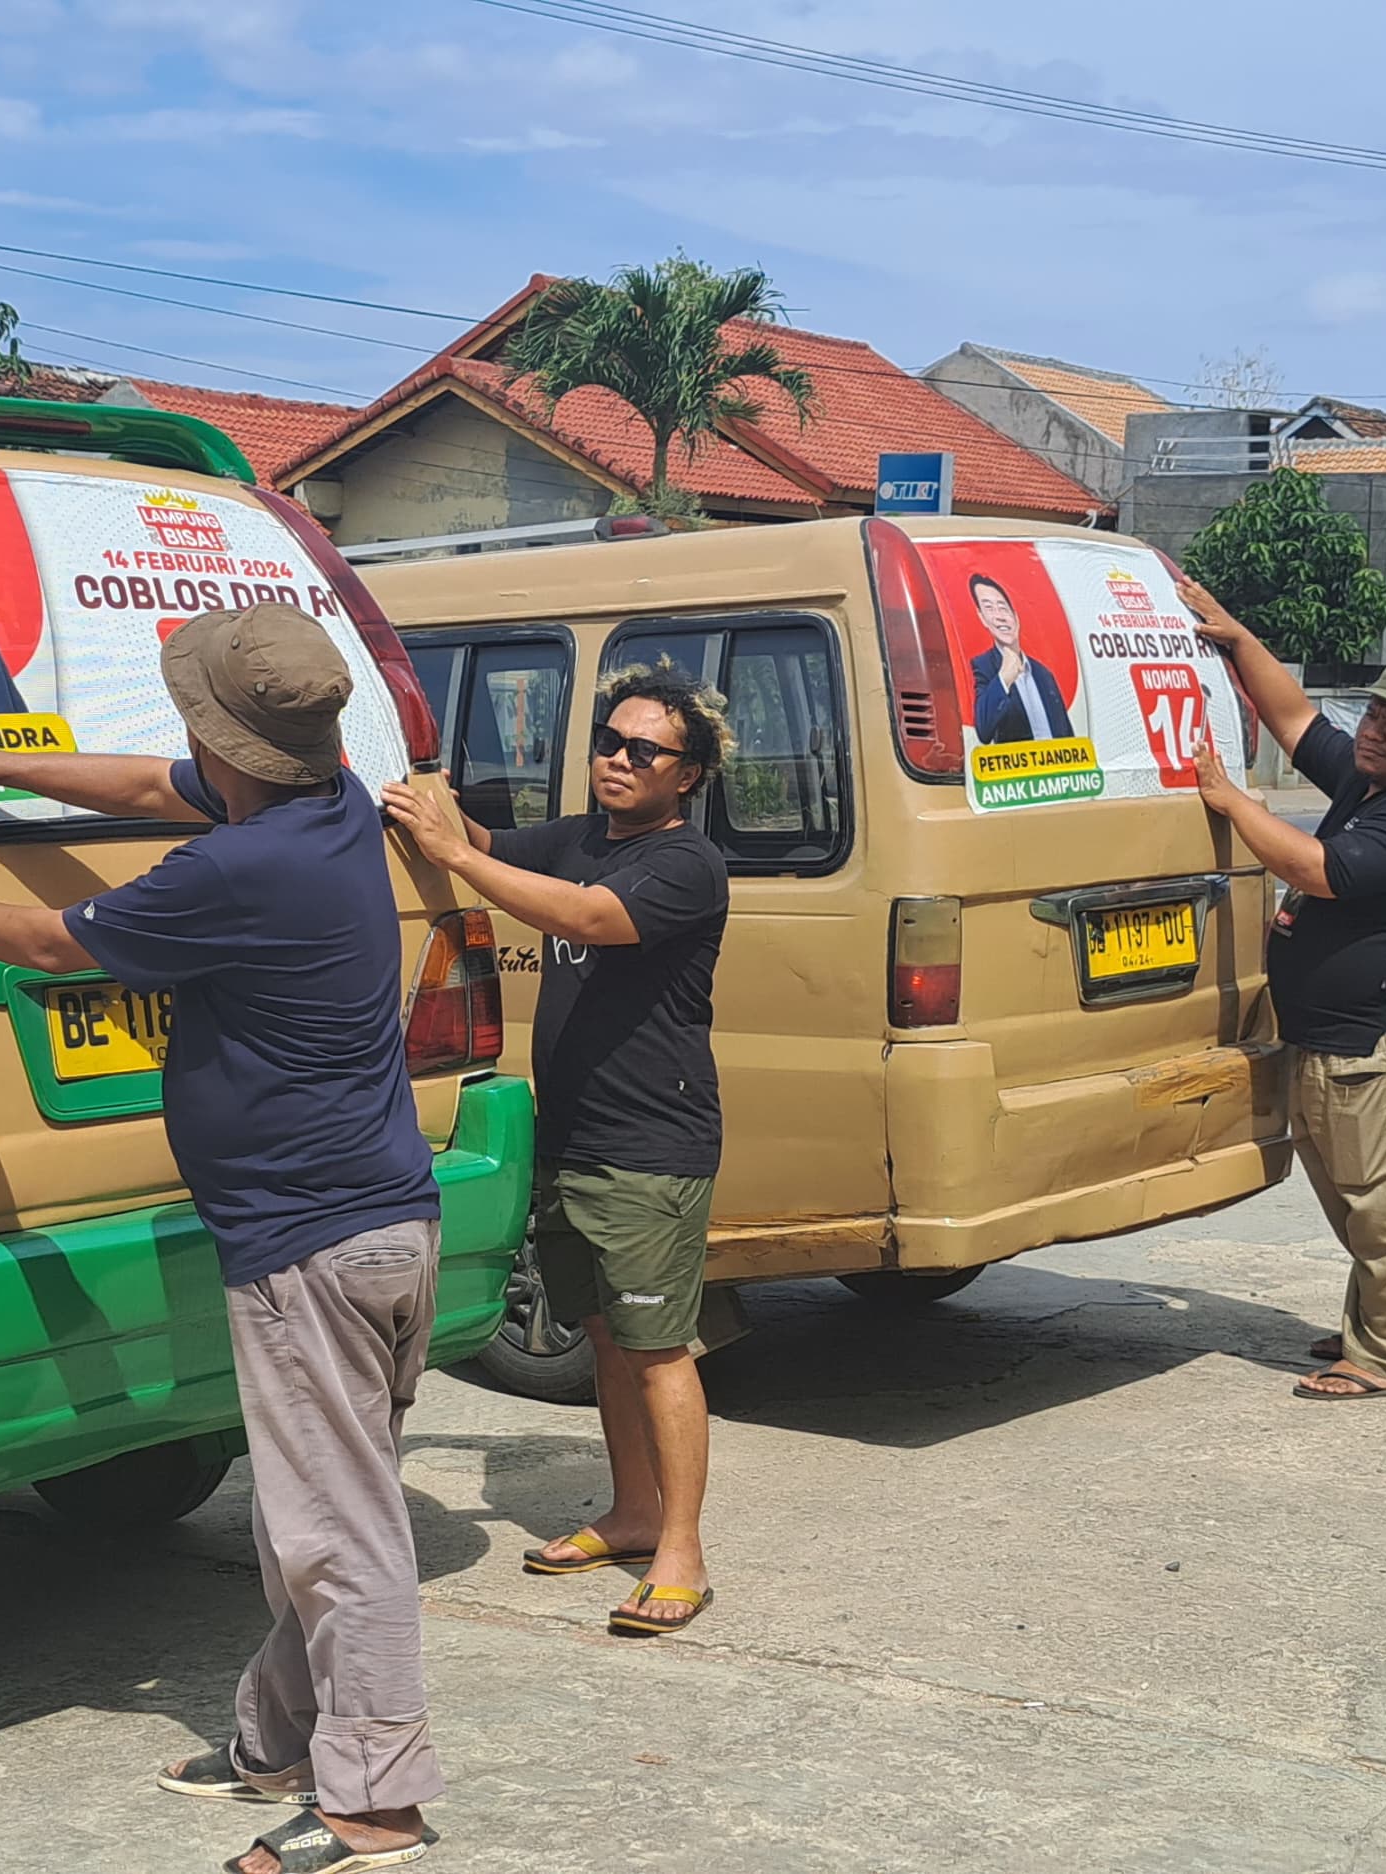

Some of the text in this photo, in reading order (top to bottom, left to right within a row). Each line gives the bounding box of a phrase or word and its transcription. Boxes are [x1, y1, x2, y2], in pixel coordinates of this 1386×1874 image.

[140, 508, 220, 529] LAMPUNG
[162, 527, 221, 549] BISA!
[102, 549, 294, 579] 14 FEBRUARI 2024
[74, 574, 225, 611] COBLOS
[1107, 581, 1146, 595] LAMPUNG
[1098, 613, 1187, 630] 14 FEBRUARI 2024
[1089, 633, 1159, 658] COBLOS
[1159, 634, 1195, 658] DPD
[1141, 669, 1191, 690] NOMOR
[979, 747, 1090, 773] PETRUS TJANDRA
[981, 774, 1102, 805] ANAK LAMPUNG
[1114, 911, 1150, 951] 1197
[1162, 911, 1186, 946] DU
[58, 992, 110, 1049] BE
